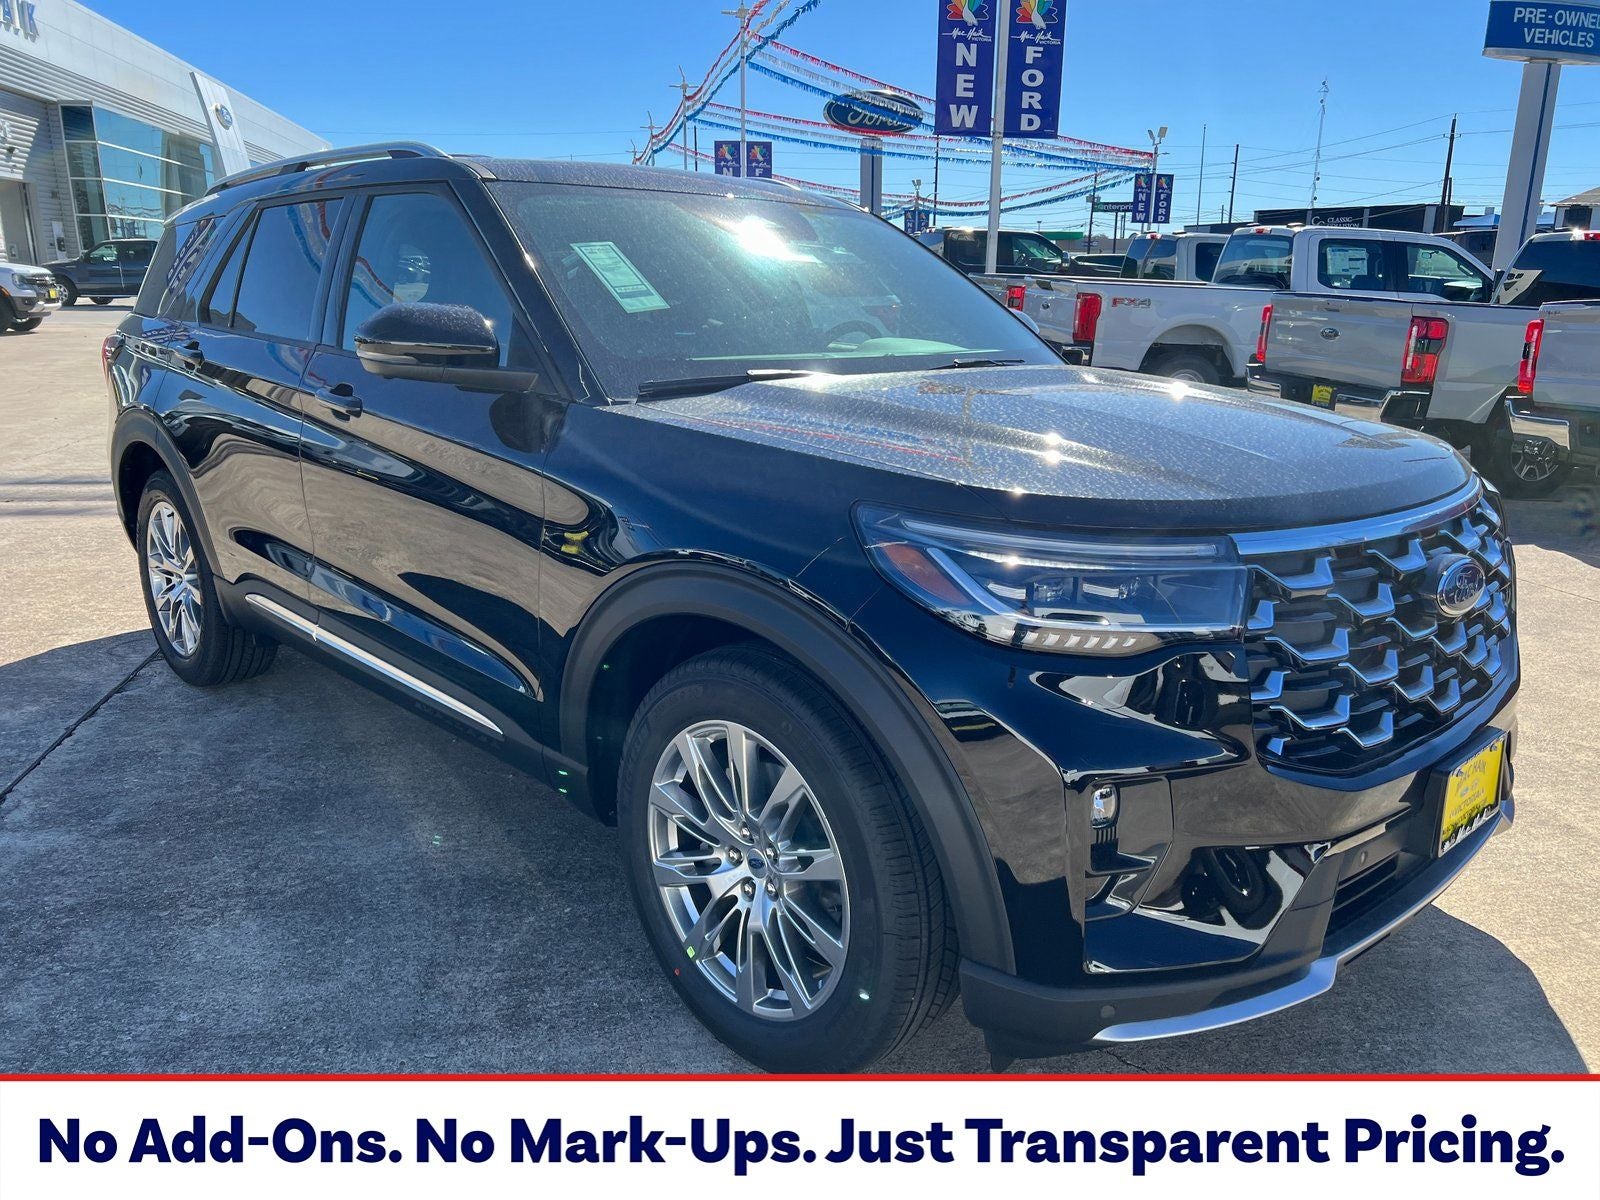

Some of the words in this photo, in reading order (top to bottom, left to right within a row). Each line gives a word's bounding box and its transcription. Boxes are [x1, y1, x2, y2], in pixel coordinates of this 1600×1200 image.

[1513, 7, 1600, 29] PRE-OWNE
[1524, 28, 1594, 48] VEHICLES
[949, 43, 978, 129] NEW
[1020, 46, 1044, 131] FORD
[1098, 201, 1133, 211] enterpri
[1135, 193, 1146, 220] NEW
[1157, 194, 1167, 222] FORD
